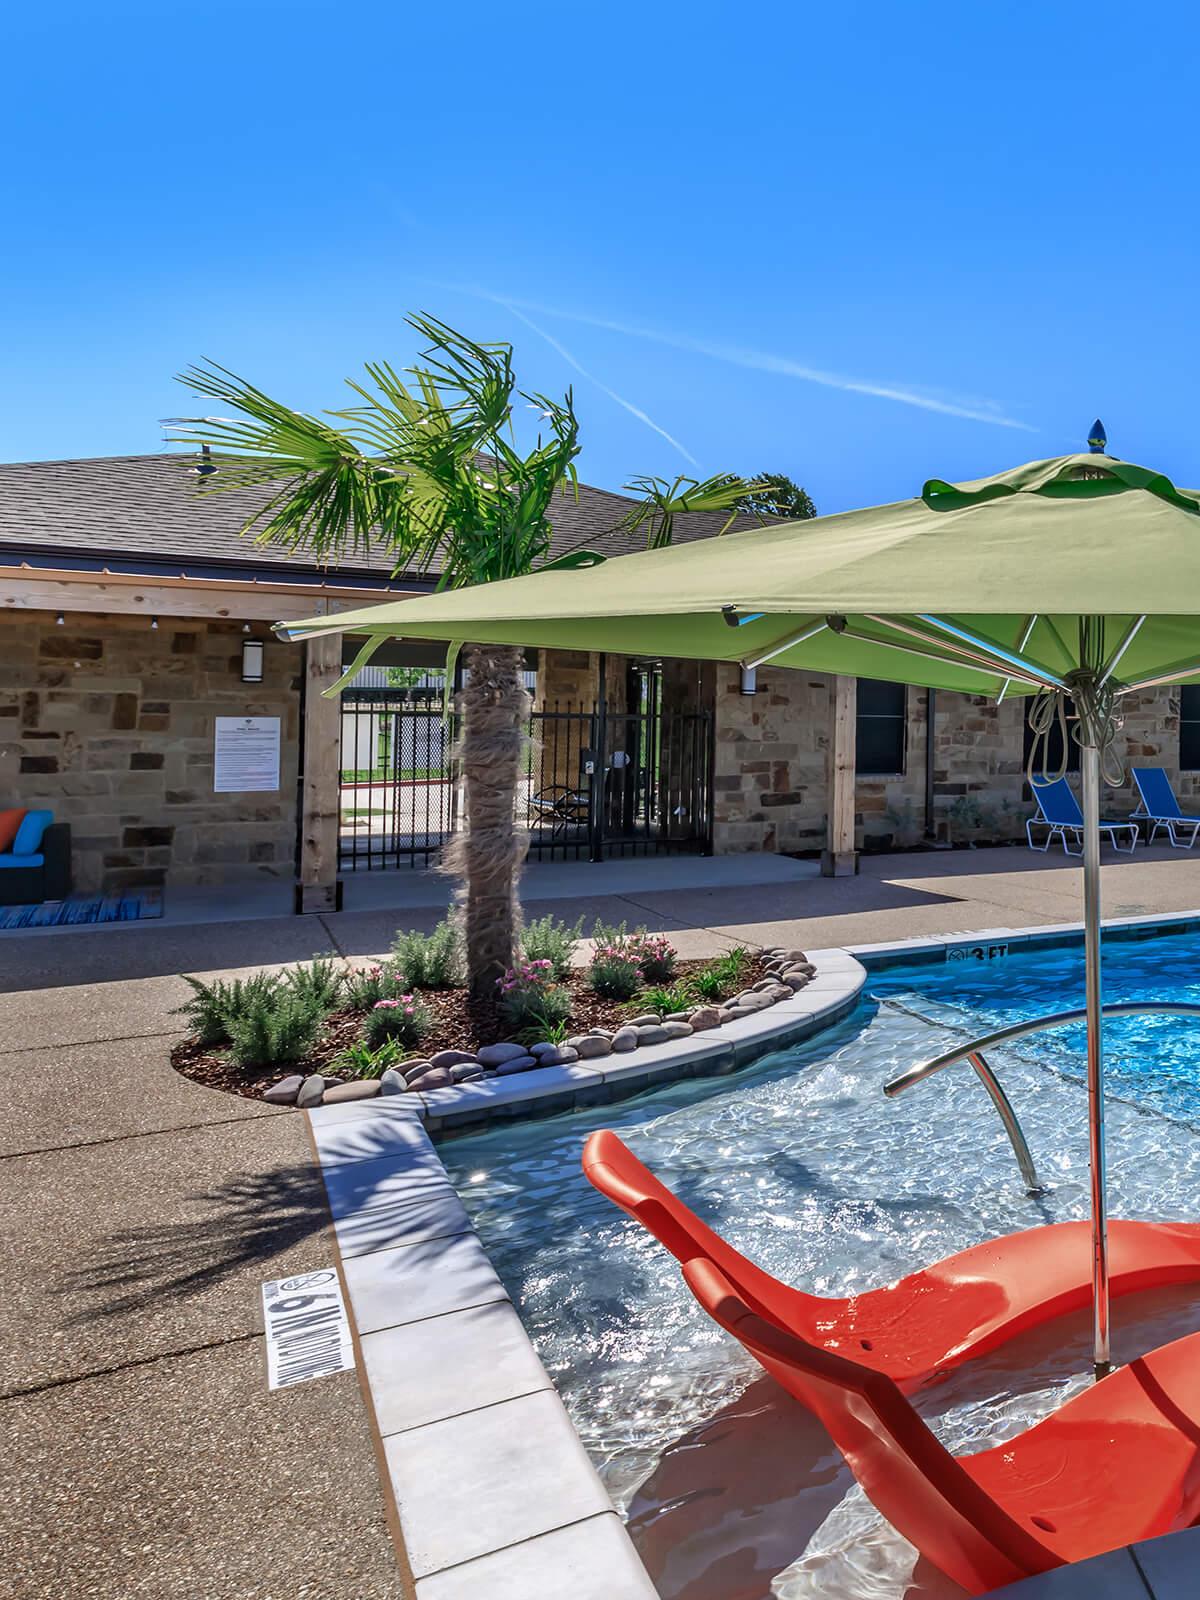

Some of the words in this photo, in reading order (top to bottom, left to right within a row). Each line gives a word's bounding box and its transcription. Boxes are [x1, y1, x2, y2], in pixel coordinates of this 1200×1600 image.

[972, 948, 985, 960] 3
[990, 945, 1007, 959] FT
[268, 1293, 338, 1313] 6
[277, 1325, 340, 1350] NO
[276, 1338, 345, 1386] DIVING
